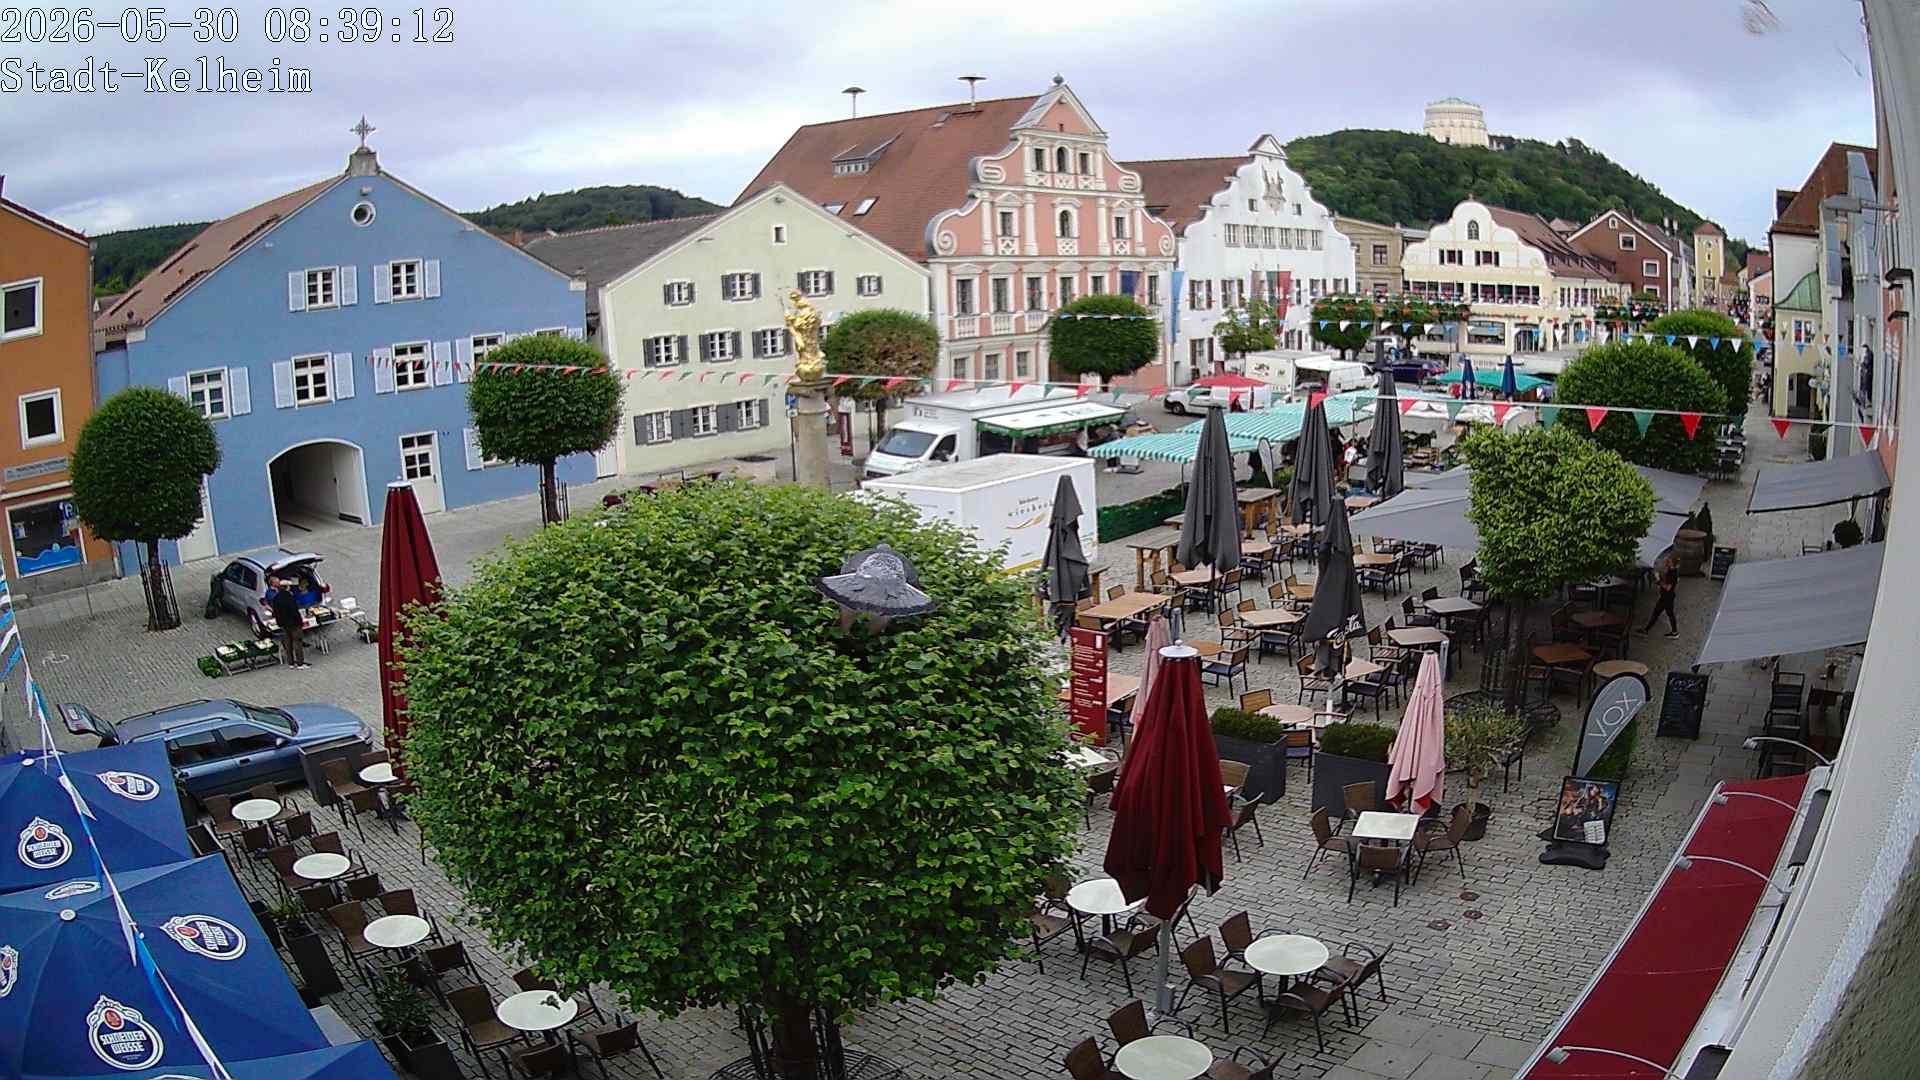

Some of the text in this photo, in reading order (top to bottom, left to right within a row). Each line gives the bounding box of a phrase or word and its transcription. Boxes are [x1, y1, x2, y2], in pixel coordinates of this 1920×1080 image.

[1587, 690, 1639, 738] VOX
[99, 1030, 147, 1046] SCHNEIDER
[110, 1041, 145, 1055] WEISSE
